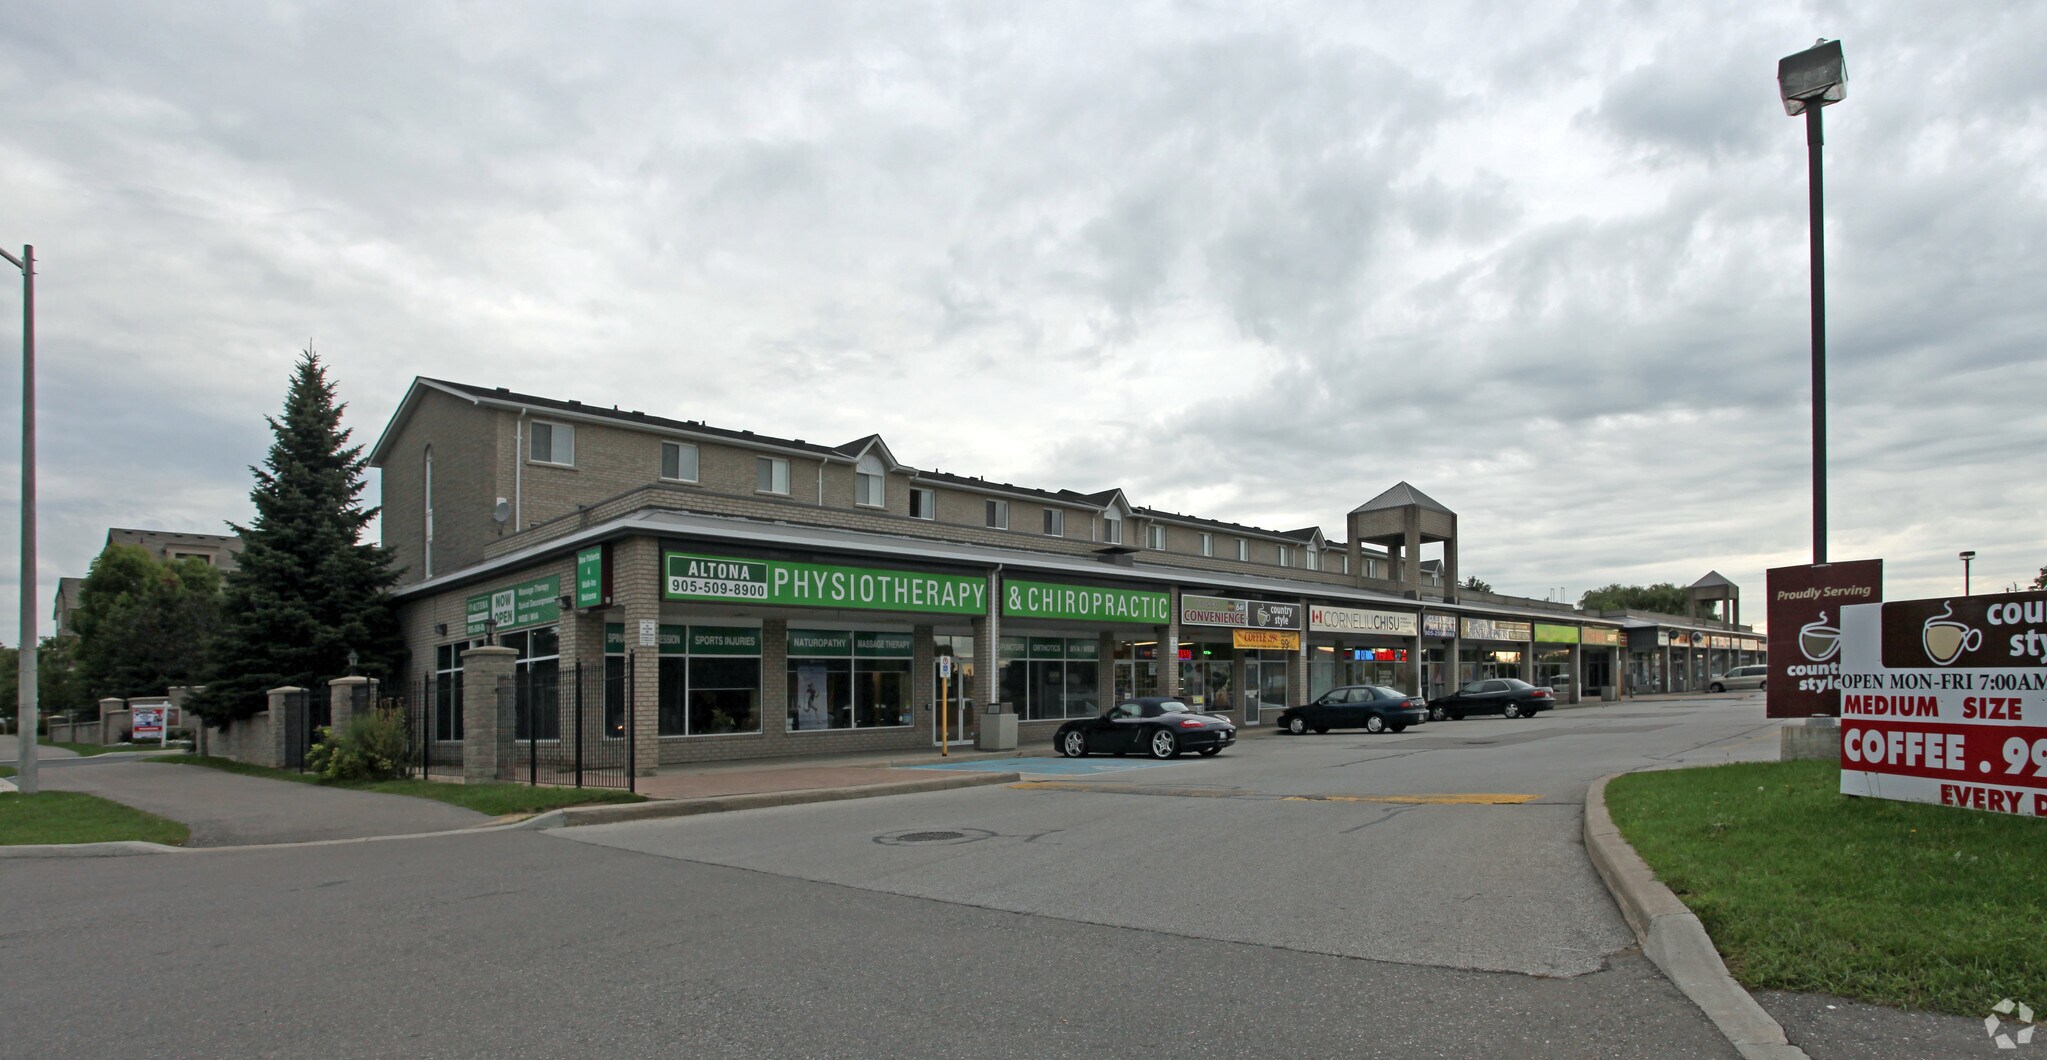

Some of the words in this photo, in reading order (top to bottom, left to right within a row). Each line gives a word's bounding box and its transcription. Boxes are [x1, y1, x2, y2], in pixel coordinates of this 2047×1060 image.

[688, 560, 750, 580] ALTONA
[672, 579, 764, 597] 905-509-8900
[774, 568, 985, 609] PHYSIOTHERAPY
[1777, 586, 1821, 601] Proudly
[1823, 585, 1871, 598] Serving
[495, 593, 511, 608] NOW
[1008, 586, 1023, 610] &
[1028, 588, 1167, 619] CHIROPRACTIC
[495, 609, 512, 624] OPEN
[1184, 609, 1246, 624] CONVENIENCE
[1270, 606, 1293, 617] country
[1987, 601, 2047, 626] cou
[1274, 616, 1289, 627] style
[695, 635, 724, 646] SPORTS
[725, 636, 755, 647] INJURIES
[794, 638, 847, 649] NATUROPATHY
[857, 639, 885, 649] MASSAGE
[885, 640, 911, 650] THERAPY
[1244, 632, 1266, 643] COFFEE
[1033, 644, 1061, 653] ORTHOTICS
[1787, 661, 1840, 676] count
[1841, 673, 1884, 689] OPEN
[1890, 673, 1973, 690] MON-FRI
[1844, 695, 1939, 717] MEDIUM
[1962, 697, 2022, 720] SIZE
[1844, 728, 1965, 771] COFFEE
[1941, 784, 2025, 814] EVERY
